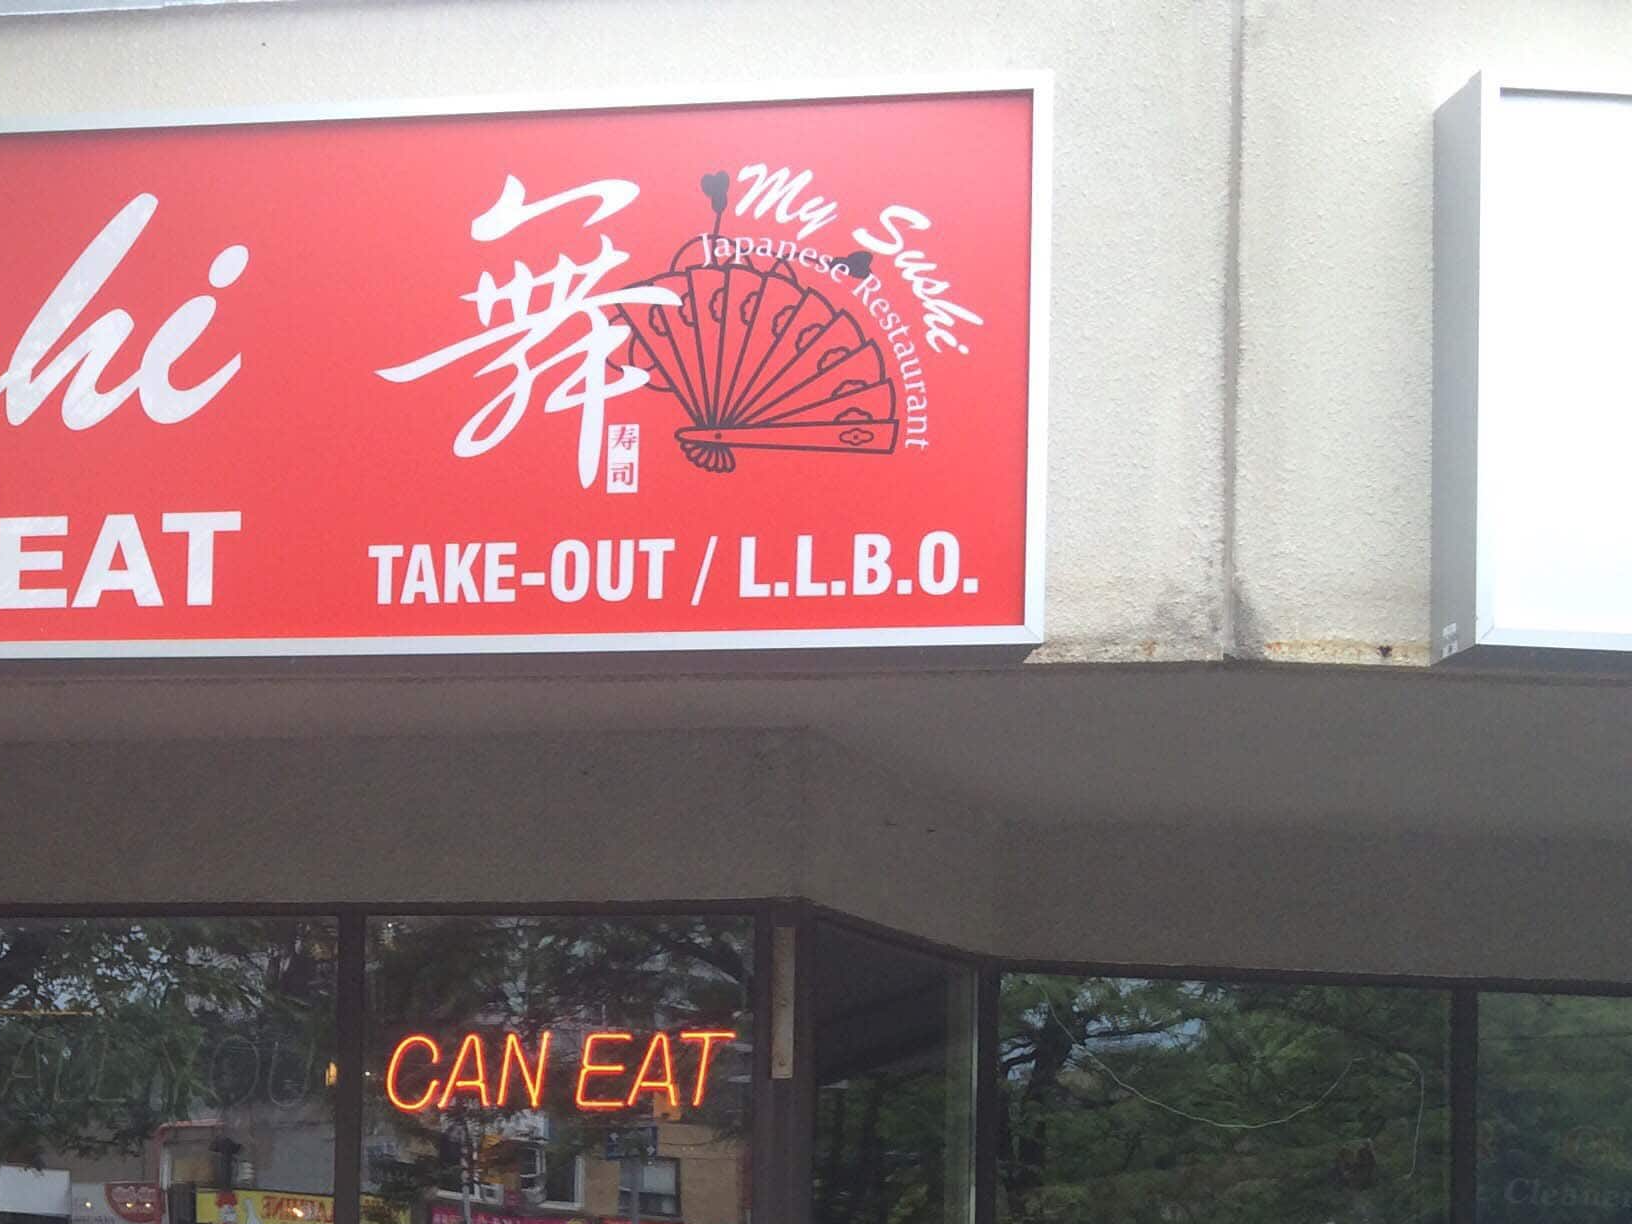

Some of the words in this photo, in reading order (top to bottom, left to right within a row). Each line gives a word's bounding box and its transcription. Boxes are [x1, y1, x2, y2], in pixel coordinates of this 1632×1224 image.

[734, 162, 839, 240] My
[851, 204, 984, 355] Sushi
[700, 232, 850, 284] Japanese
[852, 271, 930, 450] Restaurant
[610, 424, 636, 486] 寿司
[368, 538, 676, 605] TAKE-OUT
[739, 531, 980, 598] L.L.B.O.
[385, 1030, 554, 1113] CAN
[574, 1029, 737, 1110] EAT
